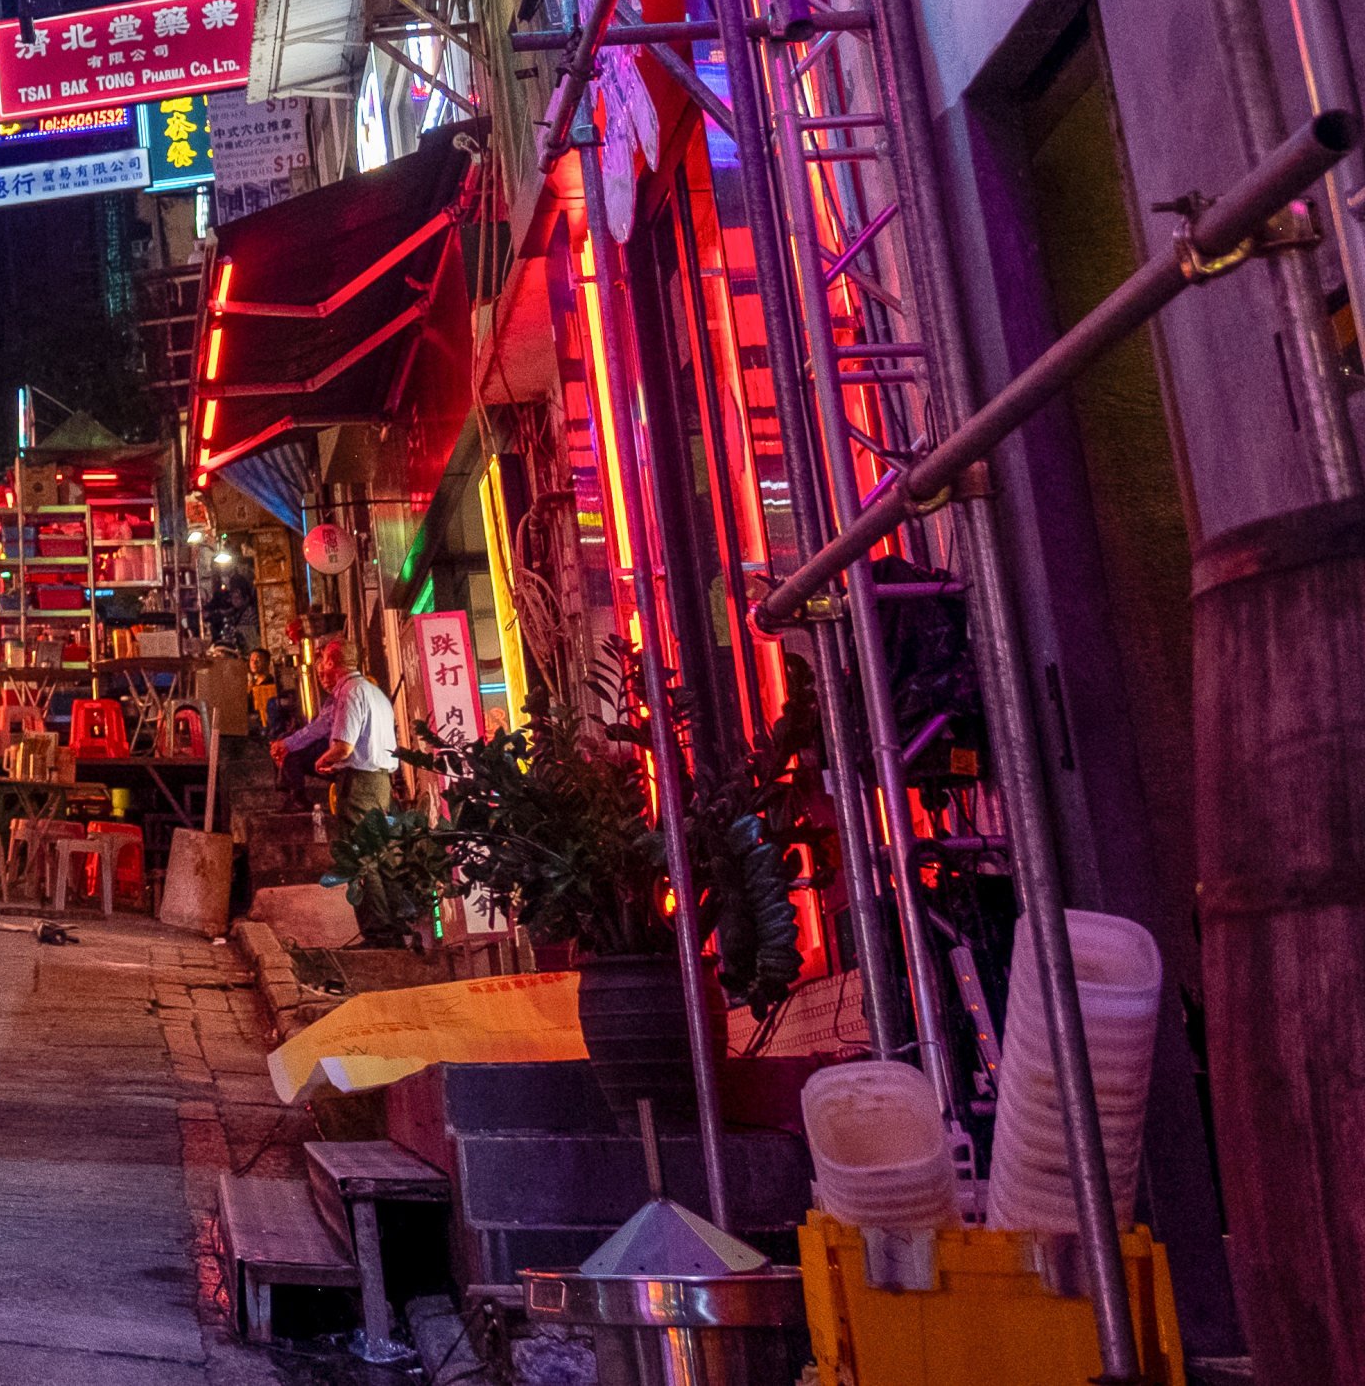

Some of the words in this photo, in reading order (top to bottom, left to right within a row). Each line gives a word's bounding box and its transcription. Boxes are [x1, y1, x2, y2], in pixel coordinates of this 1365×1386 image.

[87, 44, 170, 70] 有限公司
[18, 85, 52, 103] TSAI
[60, 78, 89, 97] BAK
[95, 71, 135, 90] TONG
[42, 156, 141, 182] 貿易有限公司
[273, 152, 307, 173] $19
[59, 182, 70, 191] TAK
[92, 175, 118, 186] TRADING
[429, 632, 464, 687] 跌打
